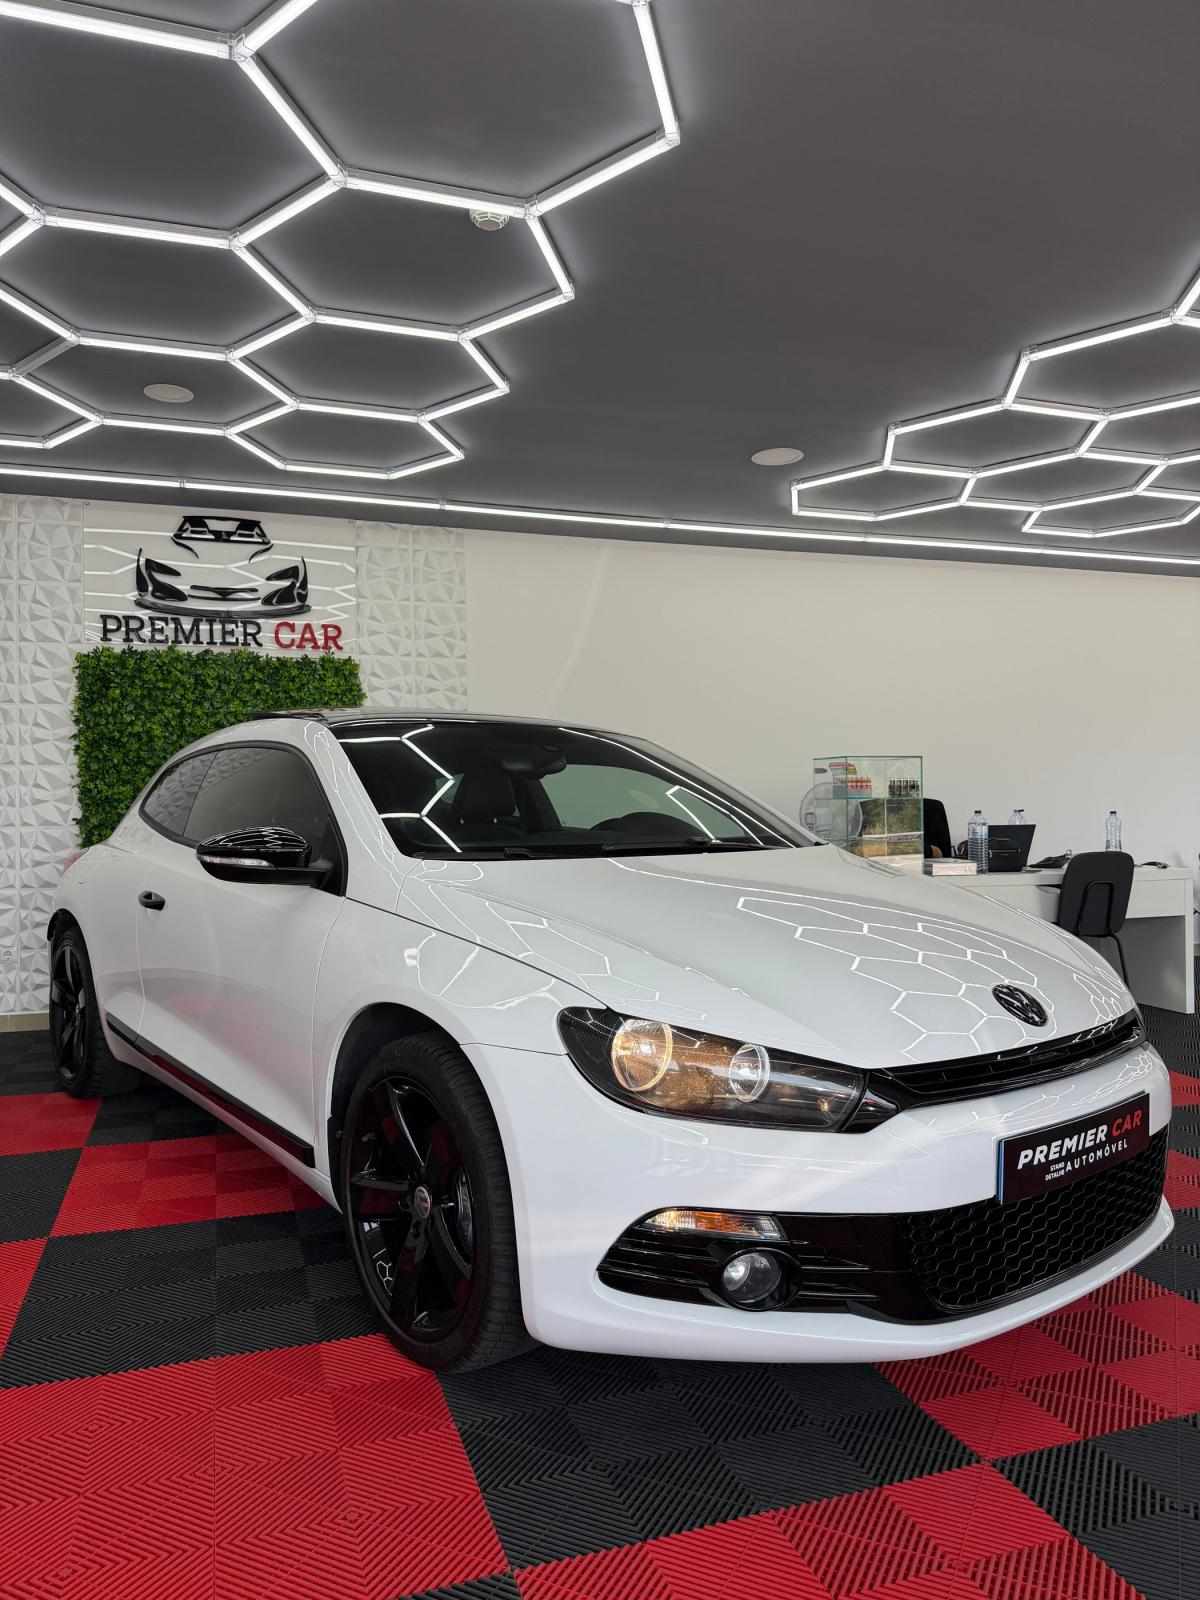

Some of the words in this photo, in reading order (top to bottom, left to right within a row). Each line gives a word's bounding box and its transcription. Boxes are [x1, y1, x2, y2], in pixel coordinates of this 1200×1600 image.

[101, 615, 262, 646] PREMIER
[274, 621, 342, 650] CAR
[1017, 1126, 1108, 1169] PREMIER
[1111, 1110, 1142, 1136] CAR
[1065, 1138, 1128, 1172] AUTOMÓVEL
